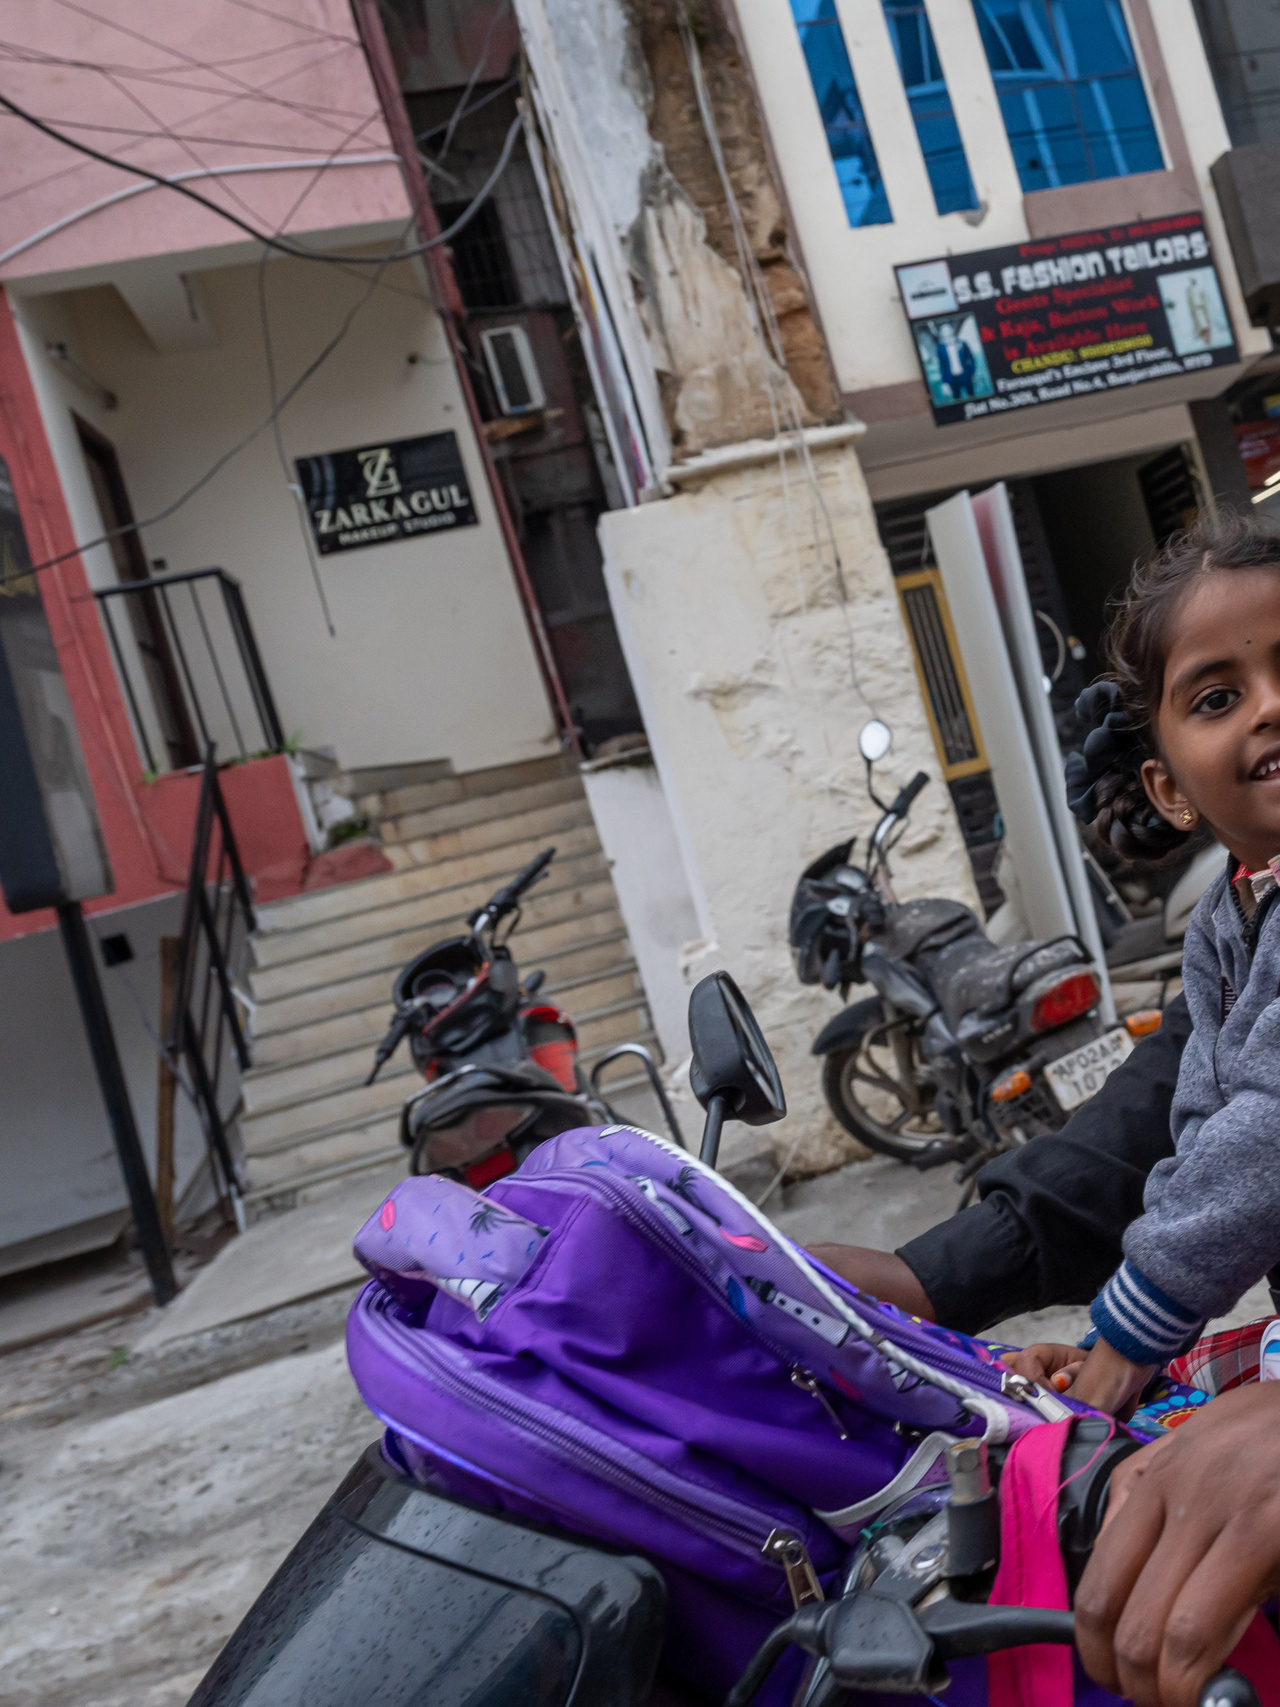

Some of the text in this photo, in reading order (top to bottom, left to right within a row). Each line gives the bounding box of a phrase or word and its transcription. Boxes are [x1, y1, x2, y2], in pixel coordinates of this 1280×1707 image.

[1111, 296, 1159, 313] Work
[1106, 321, 1147, 338] Here
[338, 511, 456, 545] MAKEUP STUDIO
